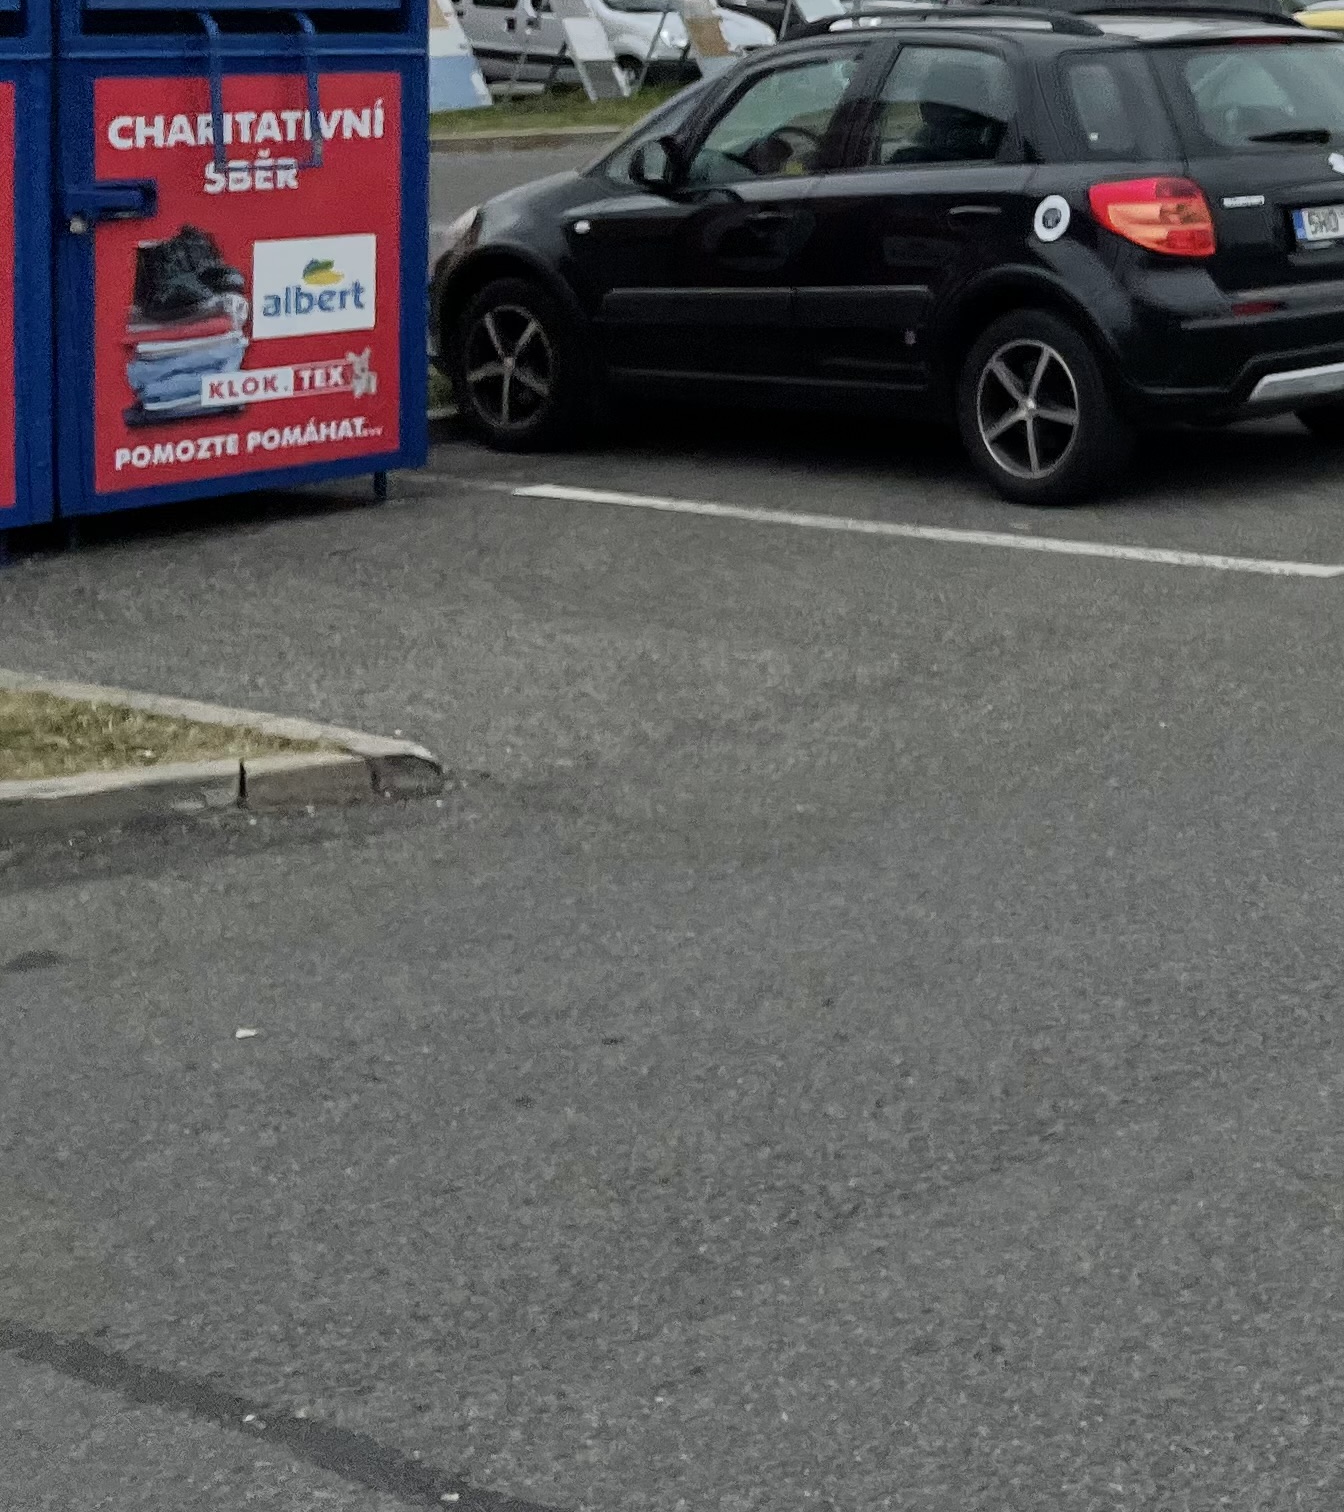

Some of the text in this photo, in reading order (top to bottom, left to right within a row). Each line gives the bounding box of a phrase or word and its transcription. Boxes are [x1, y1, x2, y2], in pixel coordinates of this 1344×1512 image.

[107, 98, 384, 150] CHARITATIVNÍ
[203, 148, 299, 195] SBĚR
[262, 280, 366, 318] albert
[301, 364, 345, 390] TEX
[115, 432, 240, 471] POMOZTE
